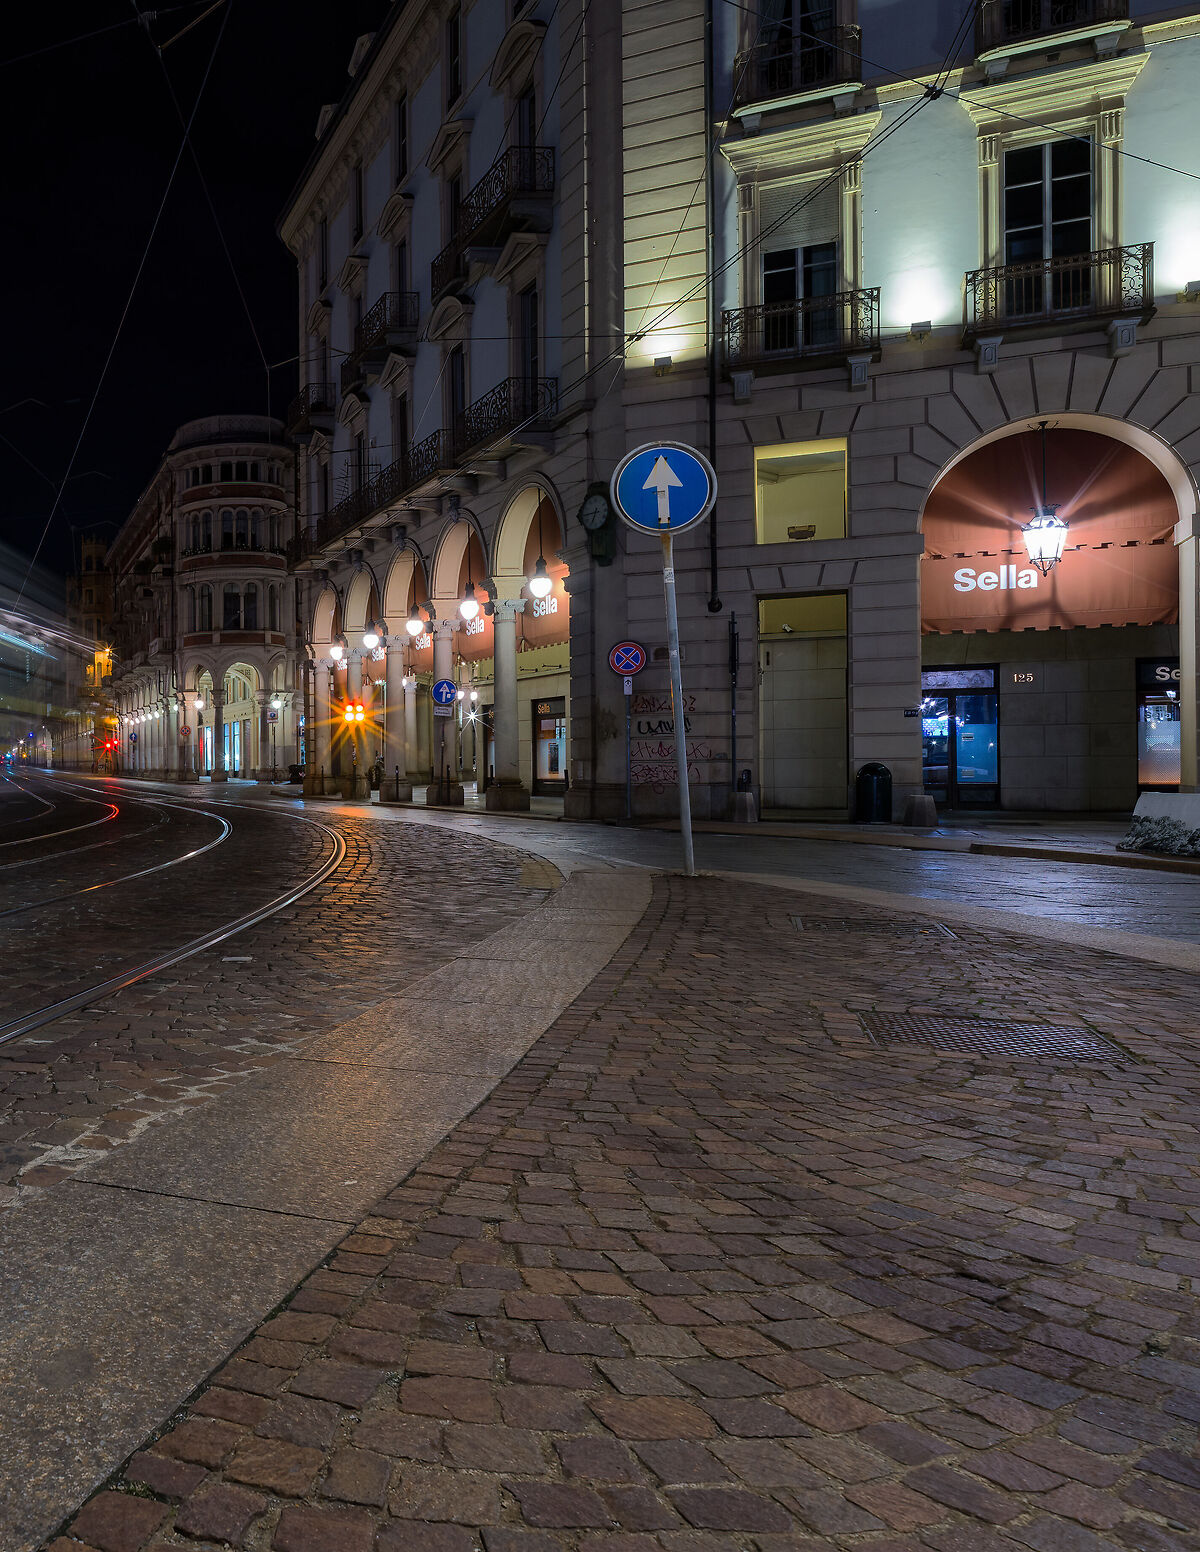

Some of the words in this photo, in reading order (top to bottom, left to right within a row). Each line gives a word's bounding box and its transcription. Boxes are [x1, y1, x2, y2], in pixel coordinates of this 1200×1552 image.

[953, 564, 1038, 592] Sella
[533, 595, 557, 617] Sella
[466, 616, 484, 635] Sella
[416, 633, 430, 650] Sella
[1013, 673, 1034, 682] 125
